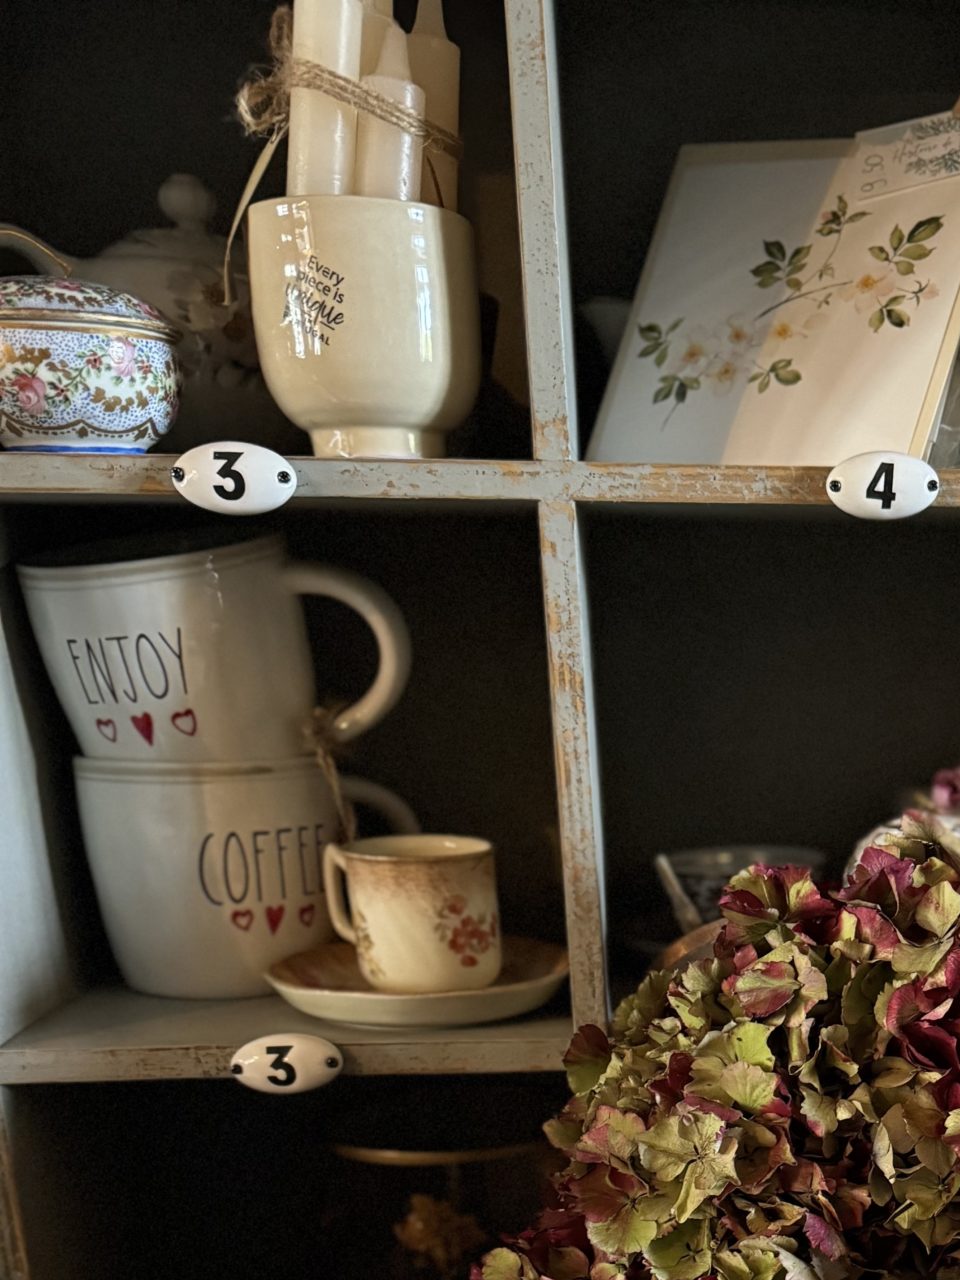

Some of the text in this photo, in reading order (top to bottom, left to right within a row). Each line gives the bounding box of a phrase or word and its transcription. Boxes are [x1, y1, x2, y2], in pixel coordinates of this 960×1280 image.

[296, 269, 345, 304] piece is
[307, 255, 345, 287] Every
[213, 451, 246, 501] 3
[865, 461, 897, 510] 4
[66, 626, 189, 705] ENJOY
[198, 823, 326, 907] COFFEE
[265, 1045, 297, 1087] 3
